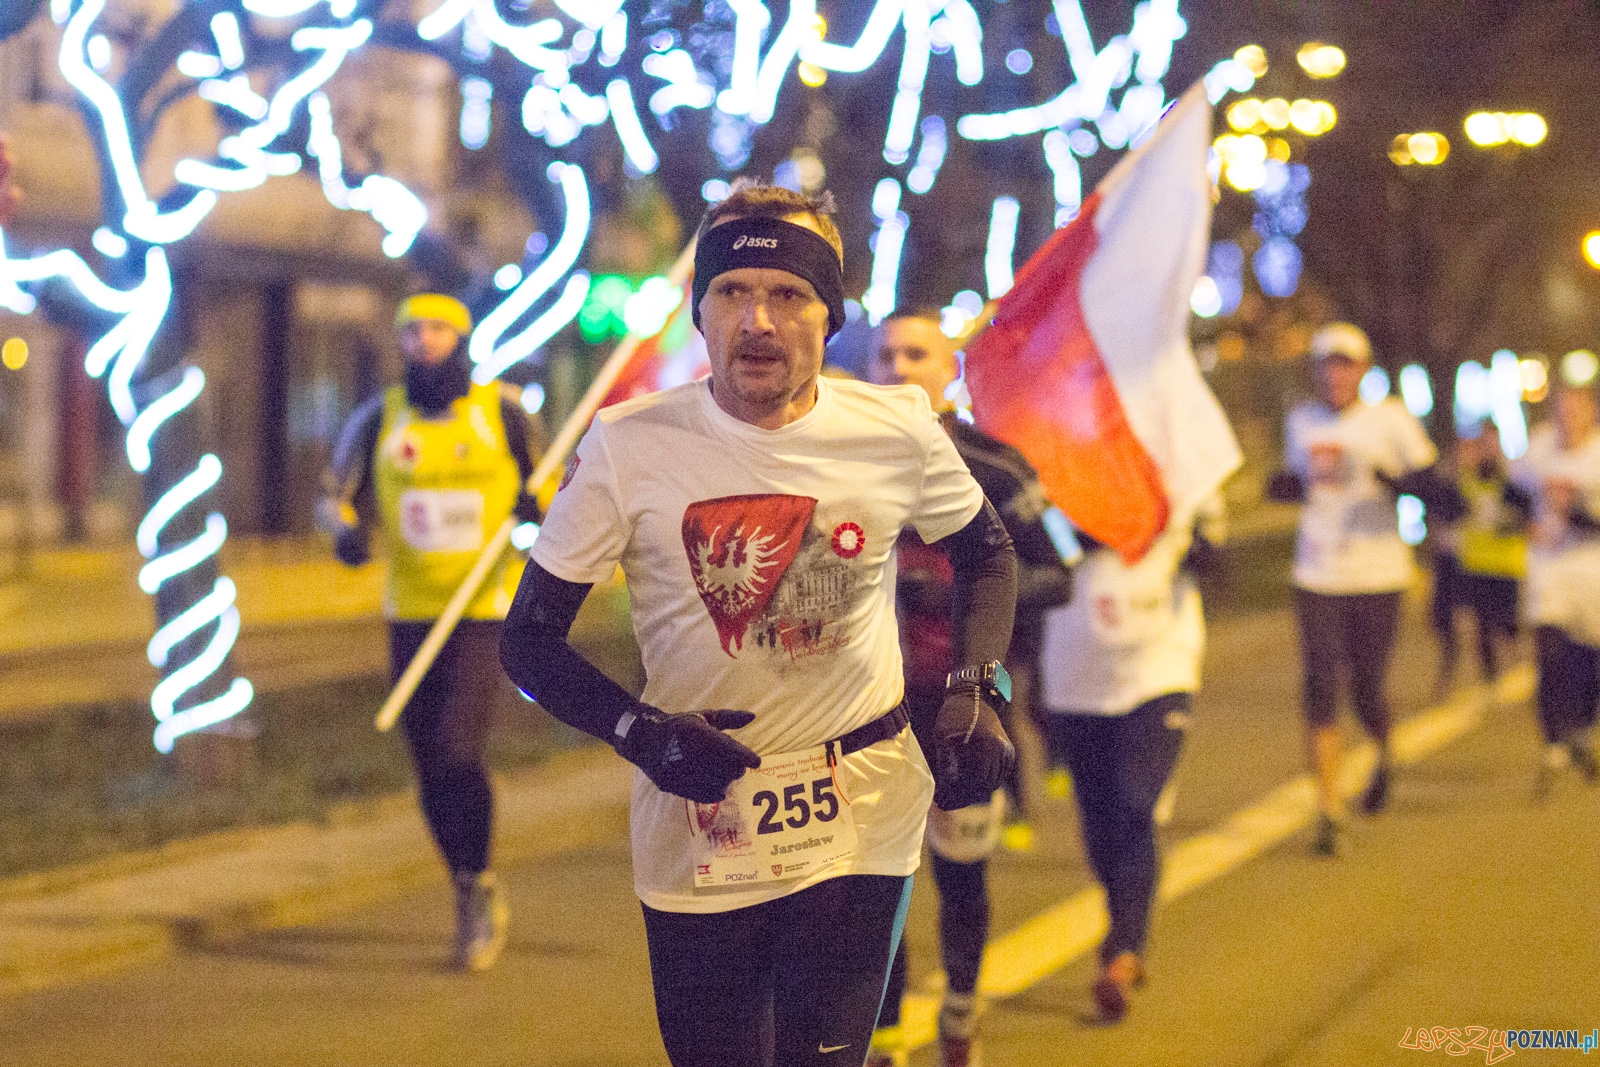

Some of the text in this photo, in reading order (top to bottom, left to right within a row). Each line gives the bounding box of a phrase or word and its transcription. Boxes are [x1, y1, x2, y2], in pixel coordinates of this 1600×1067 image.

[746, 237, 778, 249] asics
[776, 770, 798, 781] mamy
[752, 776, 839, 835] 255
[770, 835, 834, 856] Jarosław
